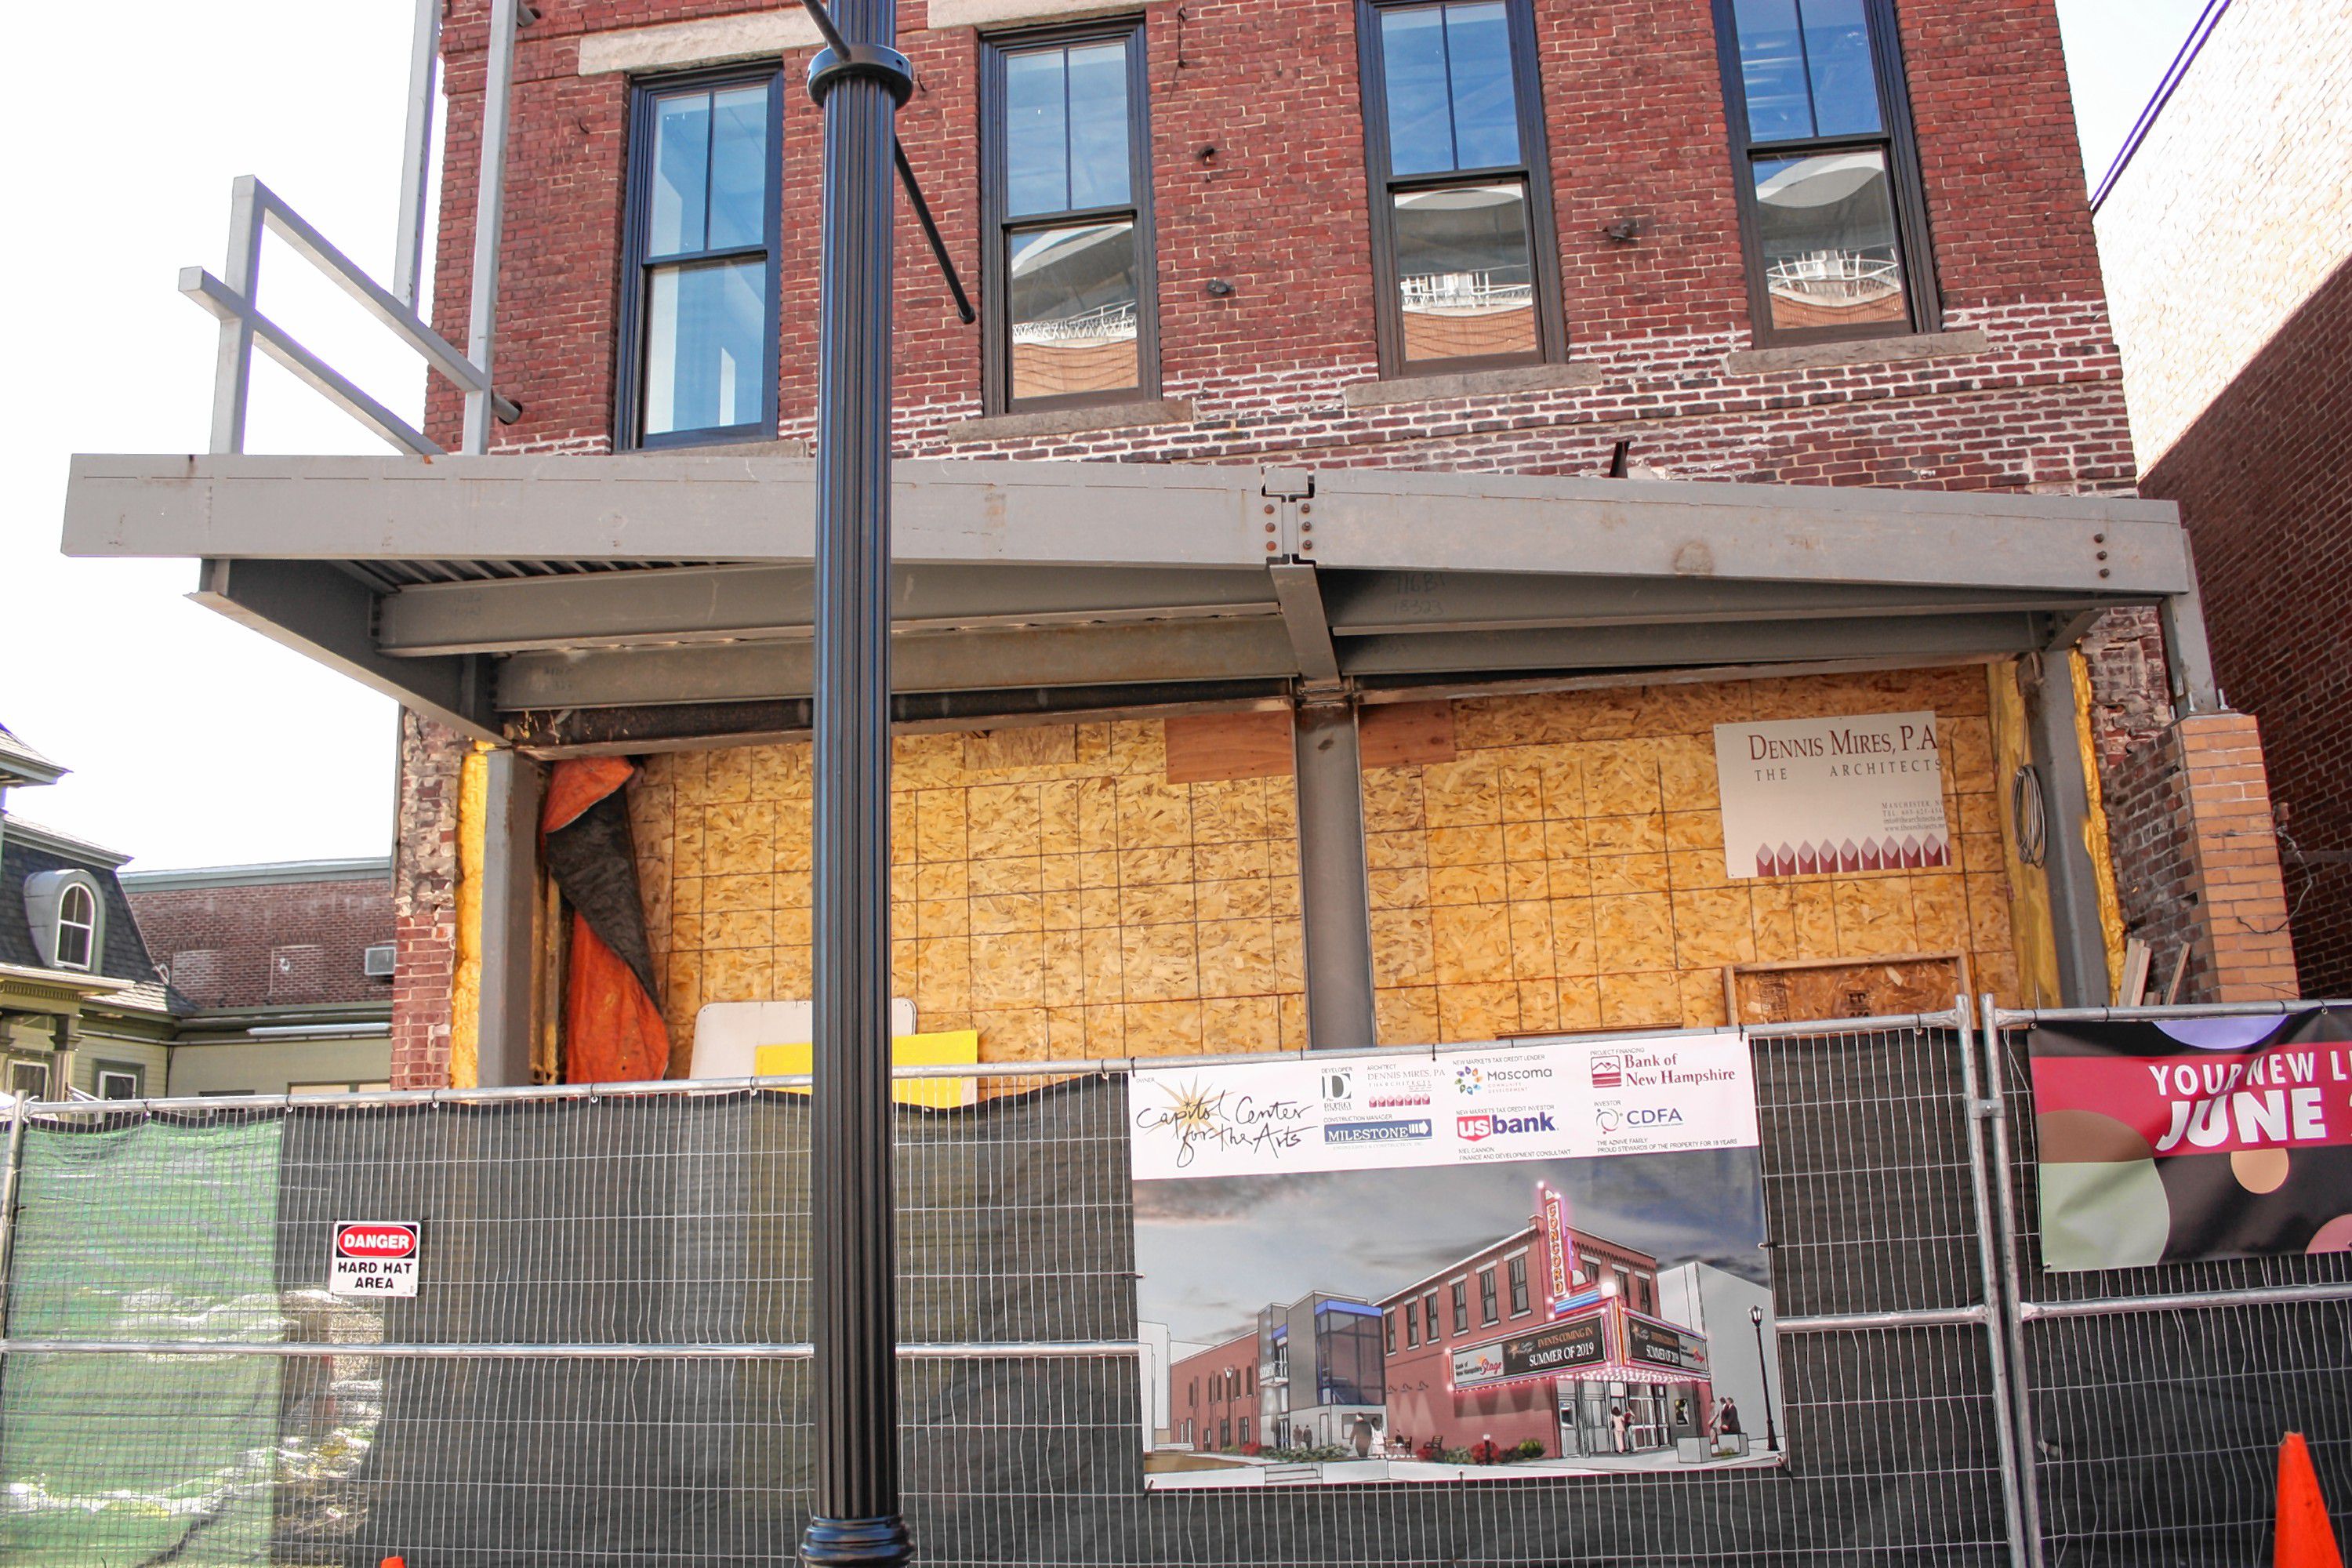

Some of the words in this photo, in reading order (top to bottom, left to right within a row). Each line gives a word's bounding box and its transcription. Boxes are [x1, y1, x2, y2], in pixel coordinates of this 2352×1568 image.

[1755, 768, 1788, 782] THE
[1830, 759, 1941, 777] ARCHITECTS
[1624, 1054, 1661, 1069] Bank
[1664, 1053, 1679, 1066] of
[1368, 1072, 1400, 1080] DENNIS
[1487, 1068, 1552, 1080] Mascoma
[1625, 1071, 1657, 1086] New
[1661, 1069, 1736, 1086] Hampshire
[2148, 1064, 2242, 1095] YOUR
[2246, 1051, 2314, 1086] NEW
[1137, 1090, 1231, 1139] Capitol
[1236, 1096, 1314, 1124] Center
[1627, 1108, 1683, 1124] CDFA
[2155, 1087, 2327, 1152] JUNE
[1254, 1123, 1319, 1158] Arts
[1327, 1127, 1410, 1142] MILESTONE
[344, 1234, 410, 1249] DANGER
[1548, 1204, 1564, 1294] CONCORD
[338, 1261, 378, 1273] HARD
[383, 1262, 412, 1274] HAT
[354, 1277, 394, 1289] AREA
[1537, 1334, 1559, 1348] EVENTS
[1559, 1328, 1584, 1343] COMING
[1529, 1348, 1563, 1367] SUMMER
[1563, 1345, 1575, 1359] OF
[1576, 1341, 1594, 1357] 2019
